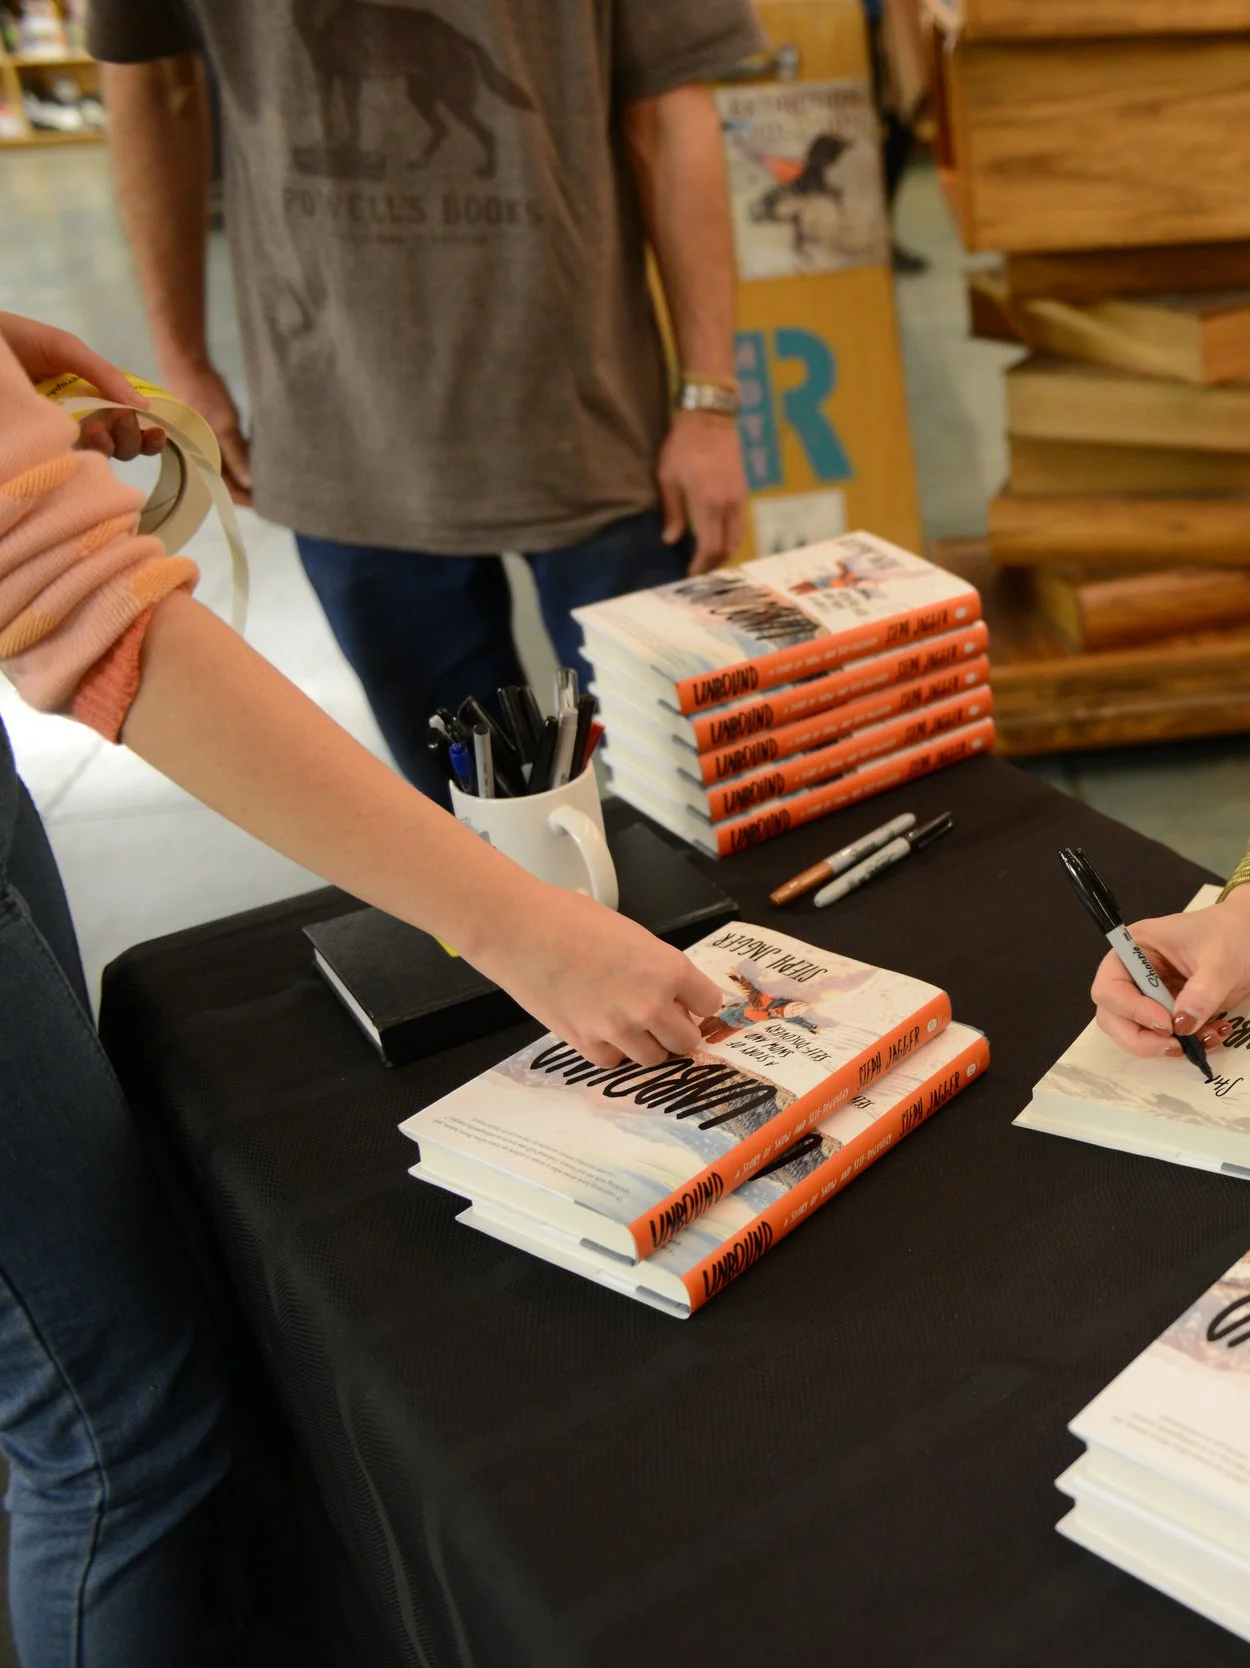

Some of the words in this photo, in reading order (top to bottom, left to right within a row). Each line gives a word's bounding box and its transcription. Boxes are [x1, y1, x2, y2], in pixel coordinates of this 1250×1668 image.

[693, 666, 760, 707] UNBOUND
[710, 703, 774, 746] UNBOUND
[715, 737, 779, 780] UNBOUND
[723, 768, 786, 815] UNBOUND
[730, 808, 792, 854] UNBOUND
[712, 932, 782, 970] JAGGER
[766, 952, 828, 983] STEPH
[1133, 944, 1159, 987] Sharpie
[725, 1039, 741, 1050] OF
[740, 1042, 769, 1063] STORY
[743, 1032, 769, 1046] AND
[763, 1024, 832, 1063] SELF-DISCOVERY
[766, 1041, 795, 1059] SNOW
[856, 1051, 882, 1090] STEPH
[885, 1026, 920, 1069] JAGGER
[900, 1097, 923, 1137] STEPH
[926, 1071, 960, 1114] JAGGER
[742, 1153, 761, 1175] STORY
[763, 1145, 771, 1158] OF
[774, 1133, 792, 1151] SNOW
[794, 1121, 807, 1135] AND
[650, 1171, 724, 1249] UNBOUND
[790, 1203, 809, 1223] STORY
[810, 1193, 820, 1207] OF
[821, 1180, 837, 1199] SNOW
[702, 1220, 773, 1297] UNBOUND
